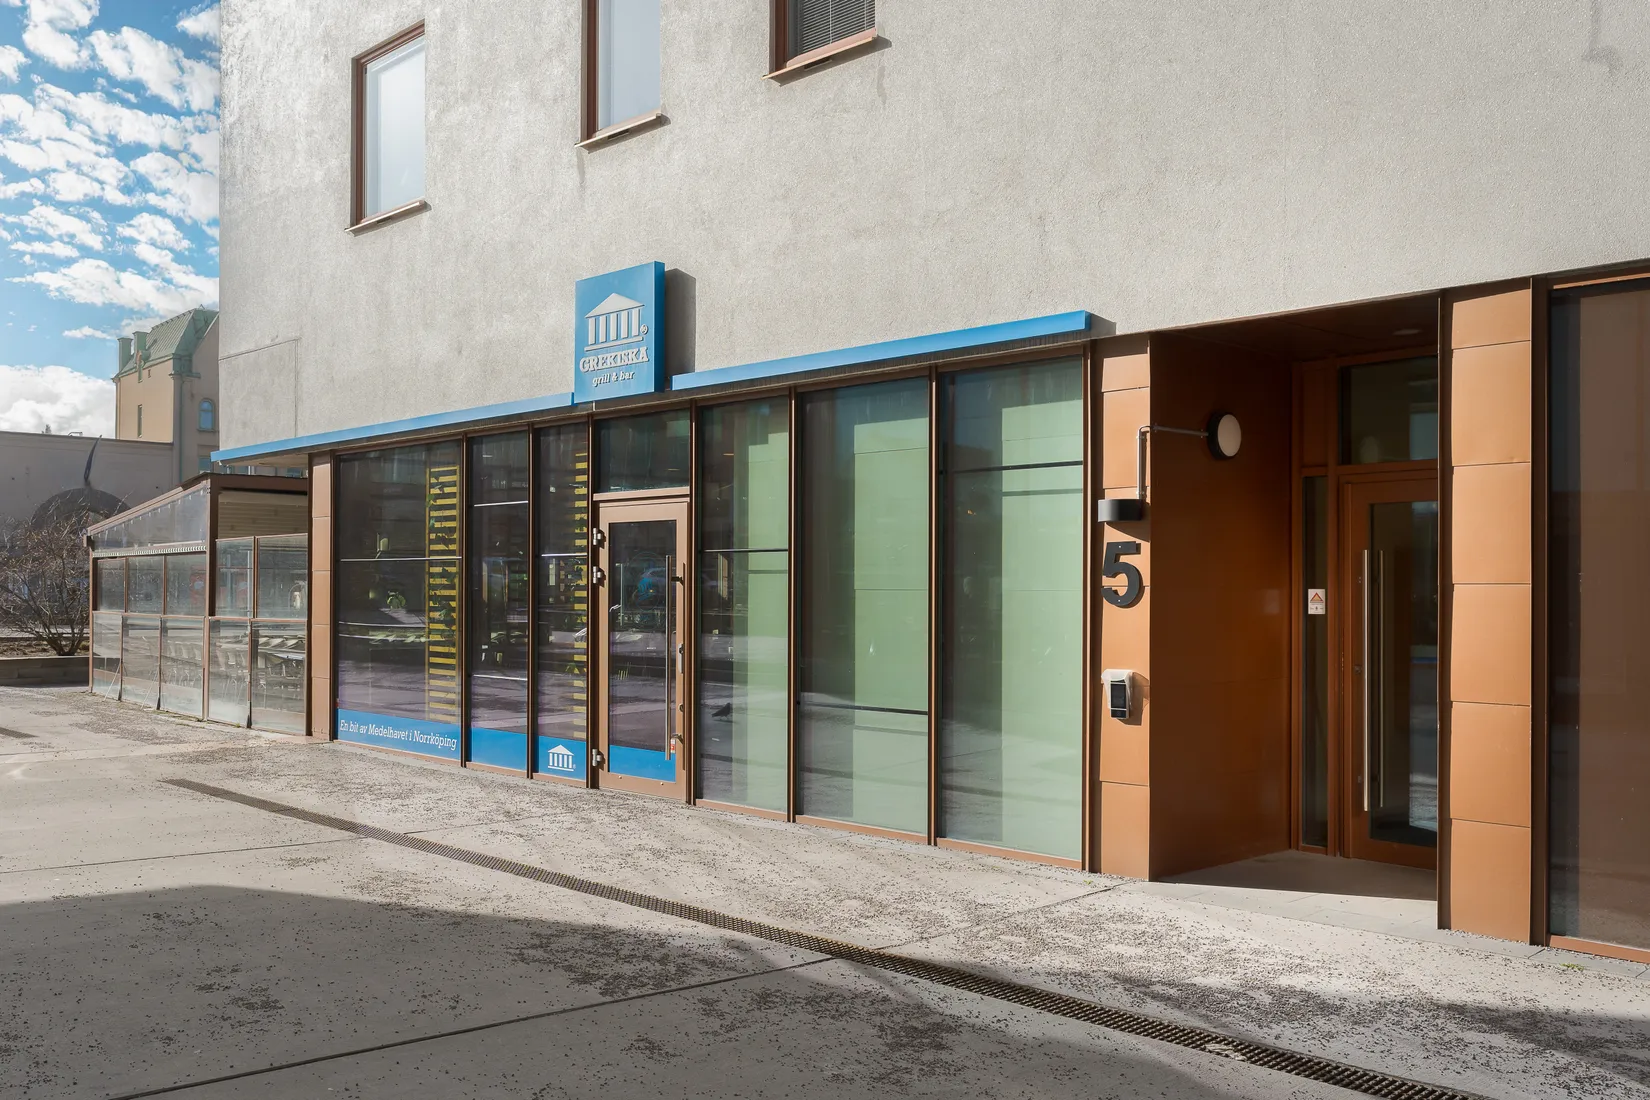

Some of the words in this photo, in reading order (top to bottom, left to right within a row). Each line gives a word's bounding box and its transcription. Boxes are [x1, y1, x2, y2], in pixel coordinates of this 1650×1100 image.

[579, 346, 649, 373] GREKISKA
[592, 373, 610, 387] grill
[611, 372, 619, 382] &
[619, 370, 635, 381] bar
[1101, 540, 1142, 607] 5
[340, 719, 349, 731] En
[349, 720, 359, 733] bit
[360, 725, 368, 734] av
[368, 723, 408, 741] Medelhavet
[413, 730, 458, 751] Norrköping
